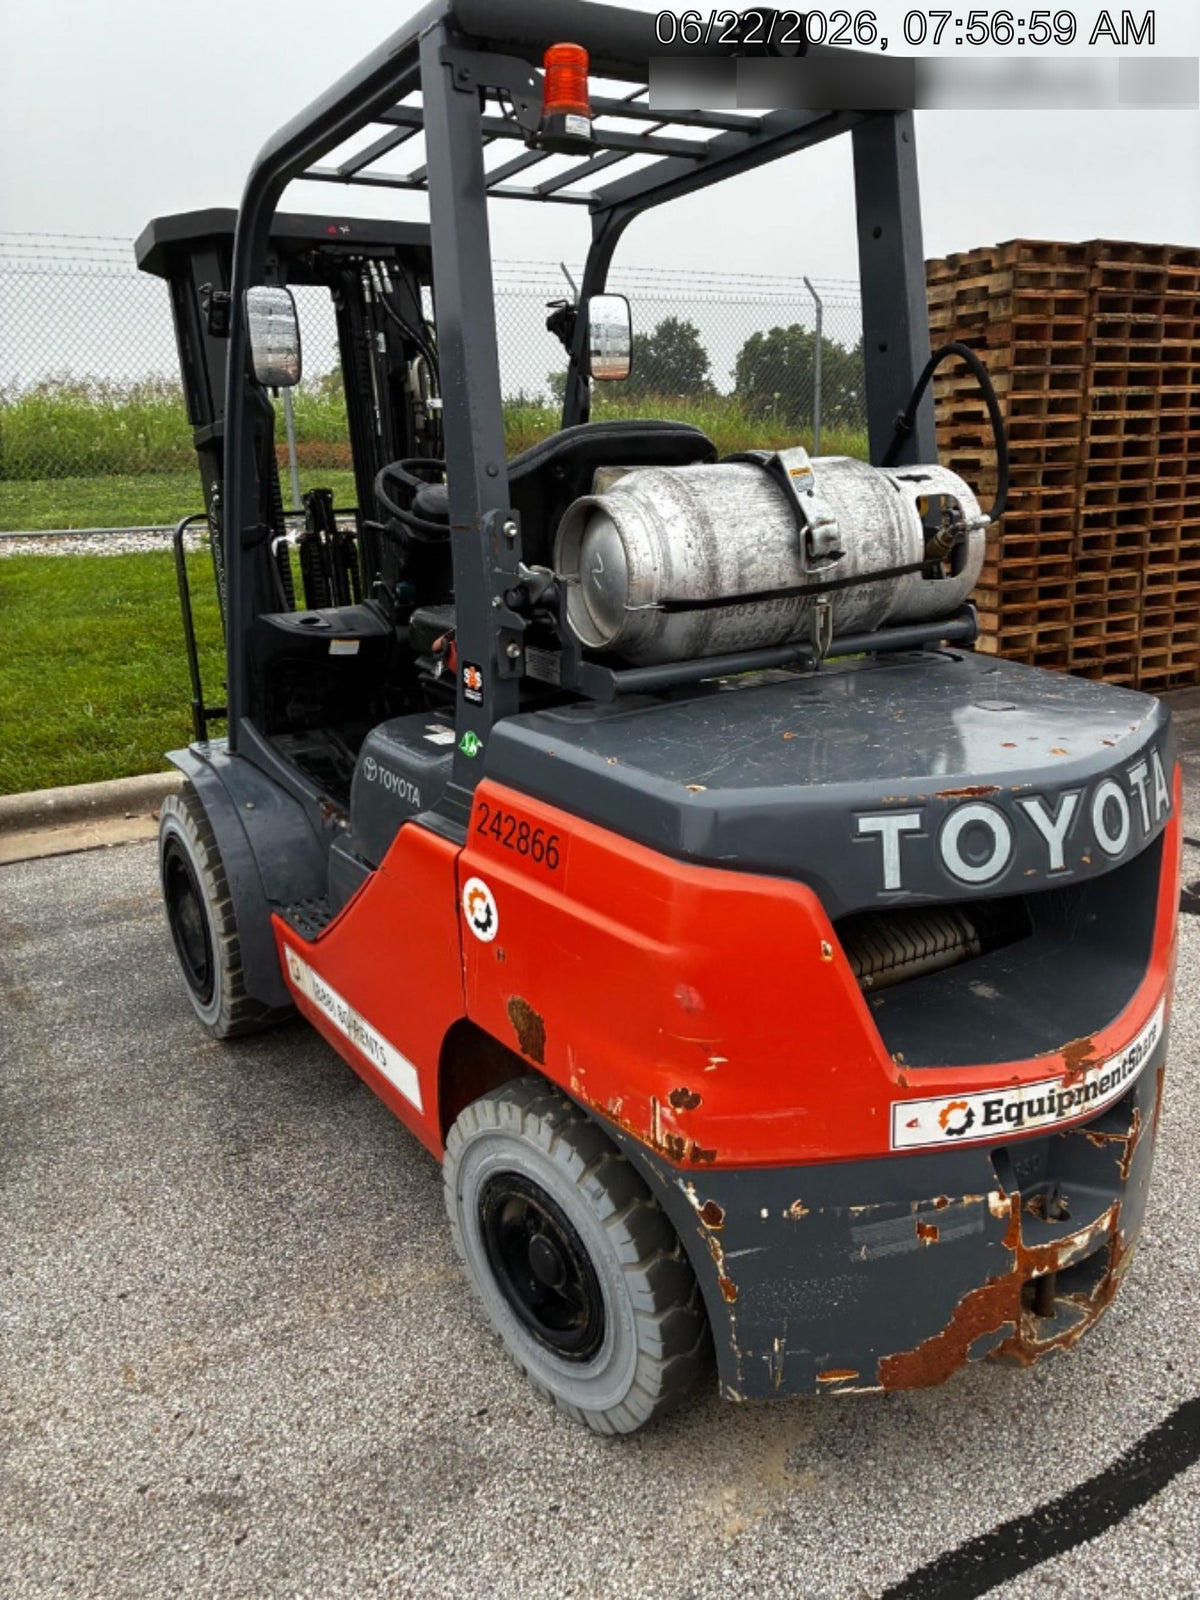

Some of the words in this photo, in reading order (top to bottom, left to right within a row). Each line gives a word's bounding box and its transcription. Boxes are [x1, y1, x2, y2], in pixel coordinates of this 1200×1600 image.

[378, 767, 421, 808] TOYOTA
[857, 751, 1170, 890] TOYOTA
[476, 803, 561, 870] 242866
